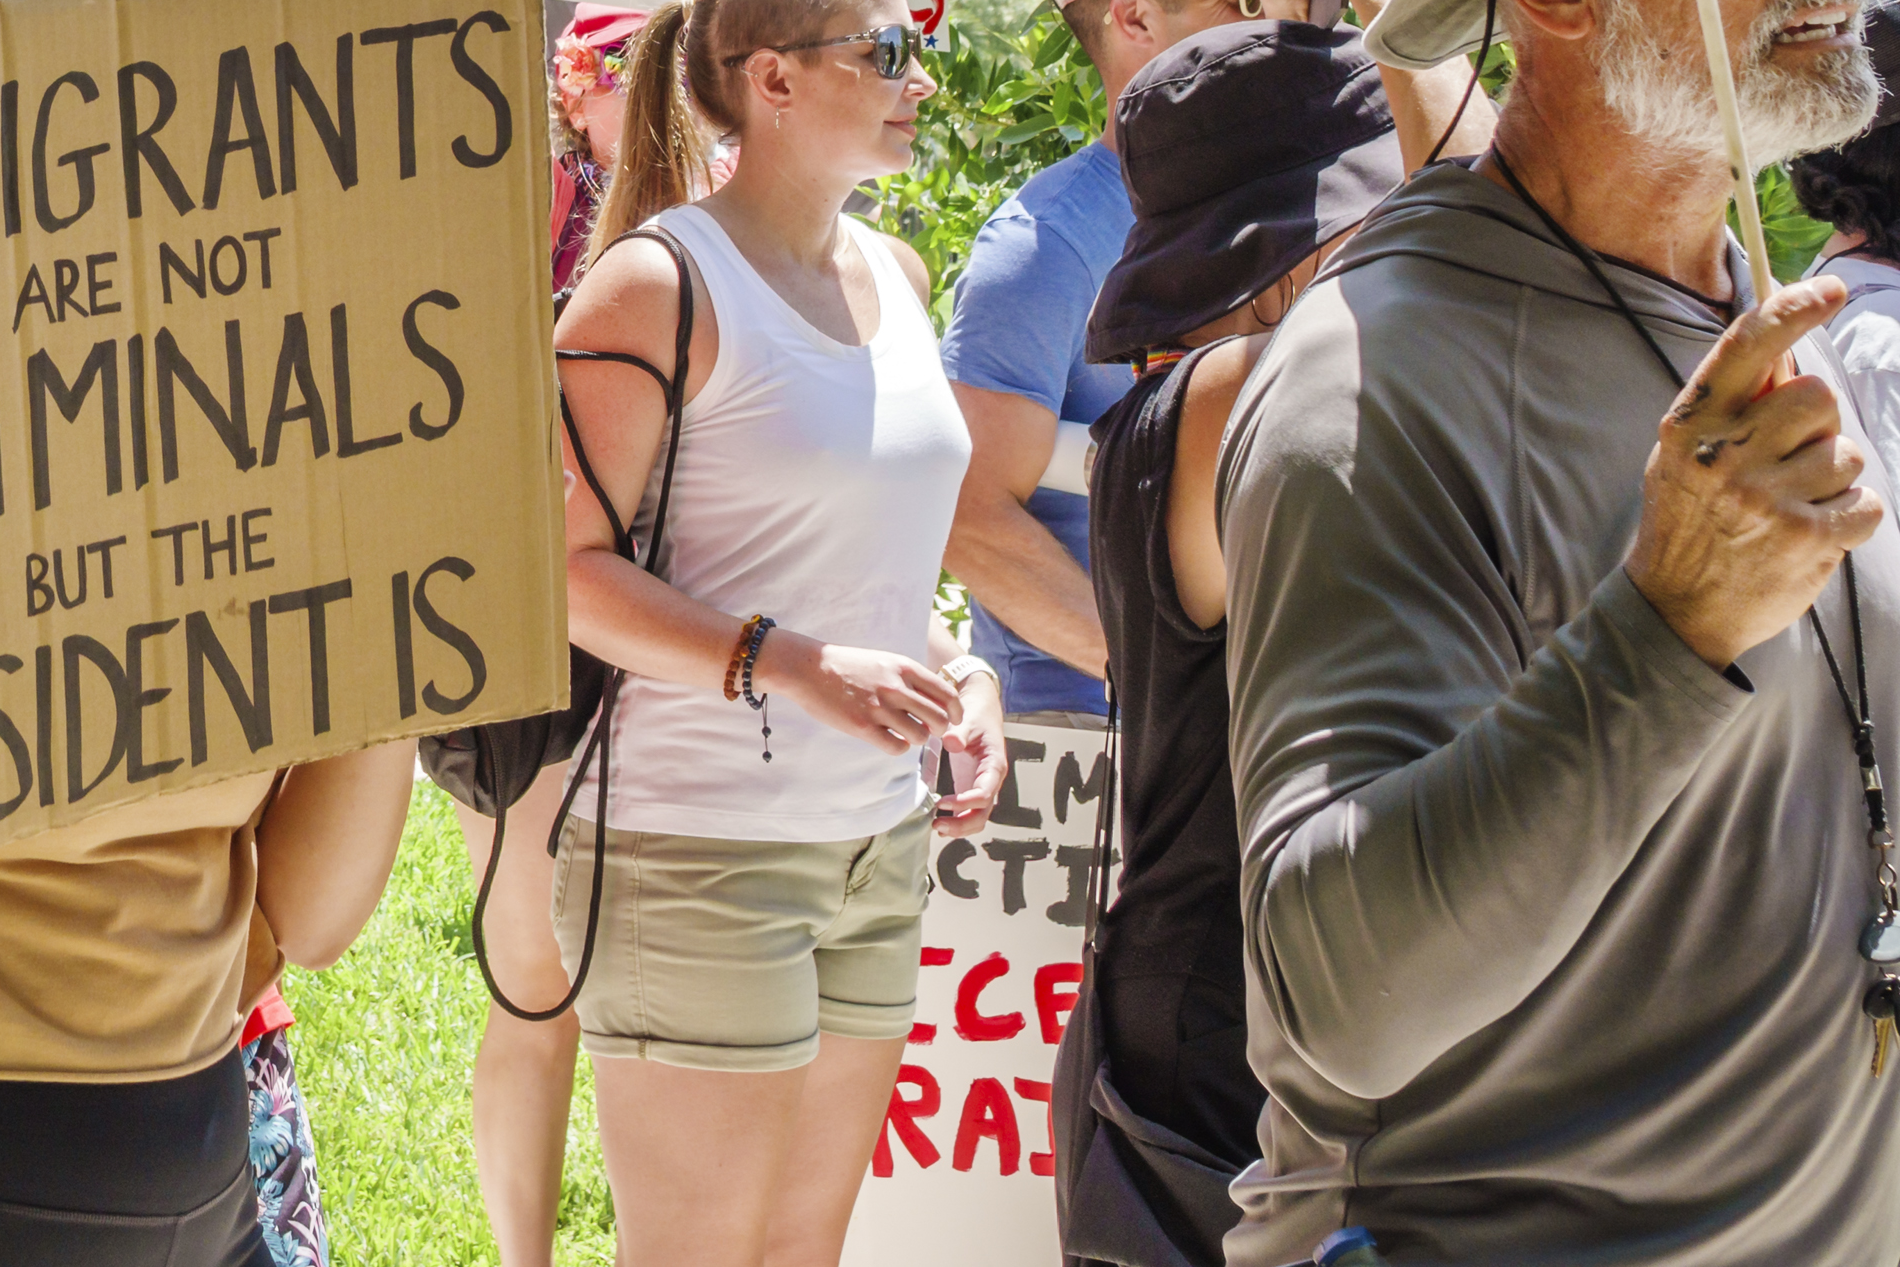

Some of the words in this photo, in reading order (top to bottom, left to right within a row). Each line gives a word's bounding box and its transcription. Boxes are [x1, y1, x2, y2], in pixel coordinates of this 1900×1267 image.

[13, 250, 121, 333] ARE
[160, 227, 281, 306] NOT
[25, 536, 127, 618] BUT
[150, 508, 276, 587] THE
[391, 556, 488, 720] IS
[871, 1064, 1056, 1178] RAI
